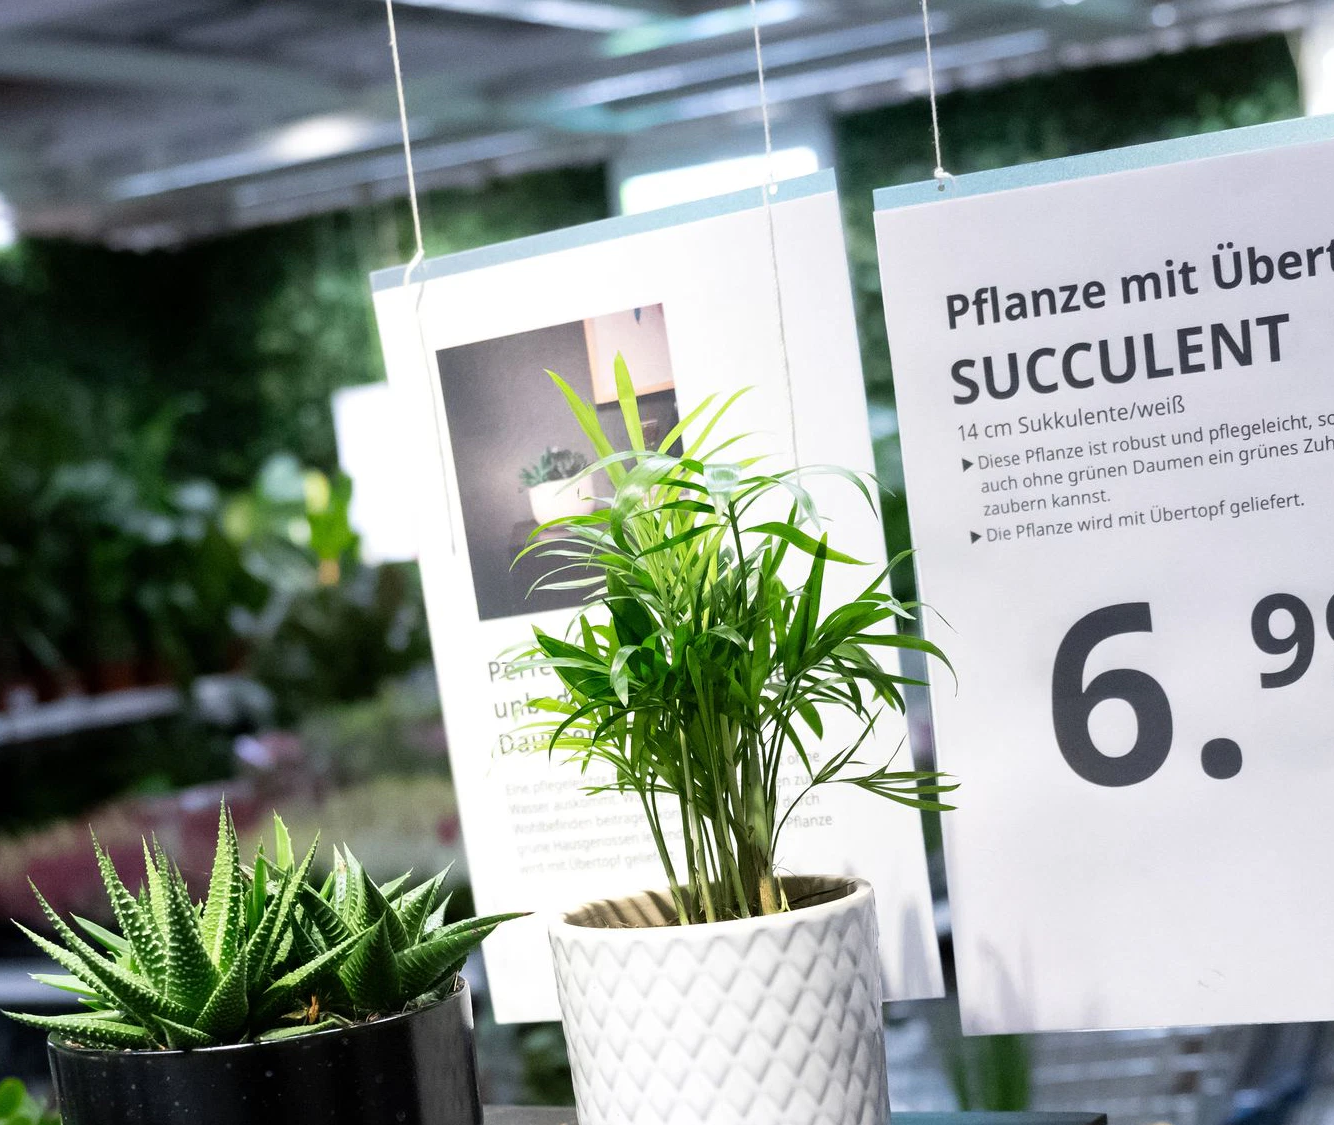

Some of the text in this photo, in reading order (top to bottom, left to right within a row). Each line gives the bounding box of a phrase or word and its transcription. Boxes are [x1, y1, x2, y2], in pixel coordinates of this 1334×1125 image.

[946, 280, 1107, 330] Pflanze
[1121, 259, 1199, 305] mit
[951, 313, 1290, 405] SUCCULENT
[958, 395, 1186, 442] 14 cm Sukkulente/weiß
[978, 454, 1020, 470] Diese
[1025, 447, 1084, 464] Pflanze
[1088, 442, 1108, 455] ist
[1112, 433, 1166, 453] robust
[1171, 427, 1203, 445] und
[1209, 415, 1312, 443] pflegeleicht,
[981, 476, 1018, 493] auch
[1023, 472, 1063, 488] ohne
[1068, 465, 1127, 486] grünen
[1132, 453, 1204, 475] Daumen
[1209, 449, 1234, 465] ein
[1239, 444, 1298, 465] grünes
[983, 490, 1111, 517] zaubern kannst.
[986, 493, 1305, 542] Die Pflanze wird mit Übertopf geliefert.
